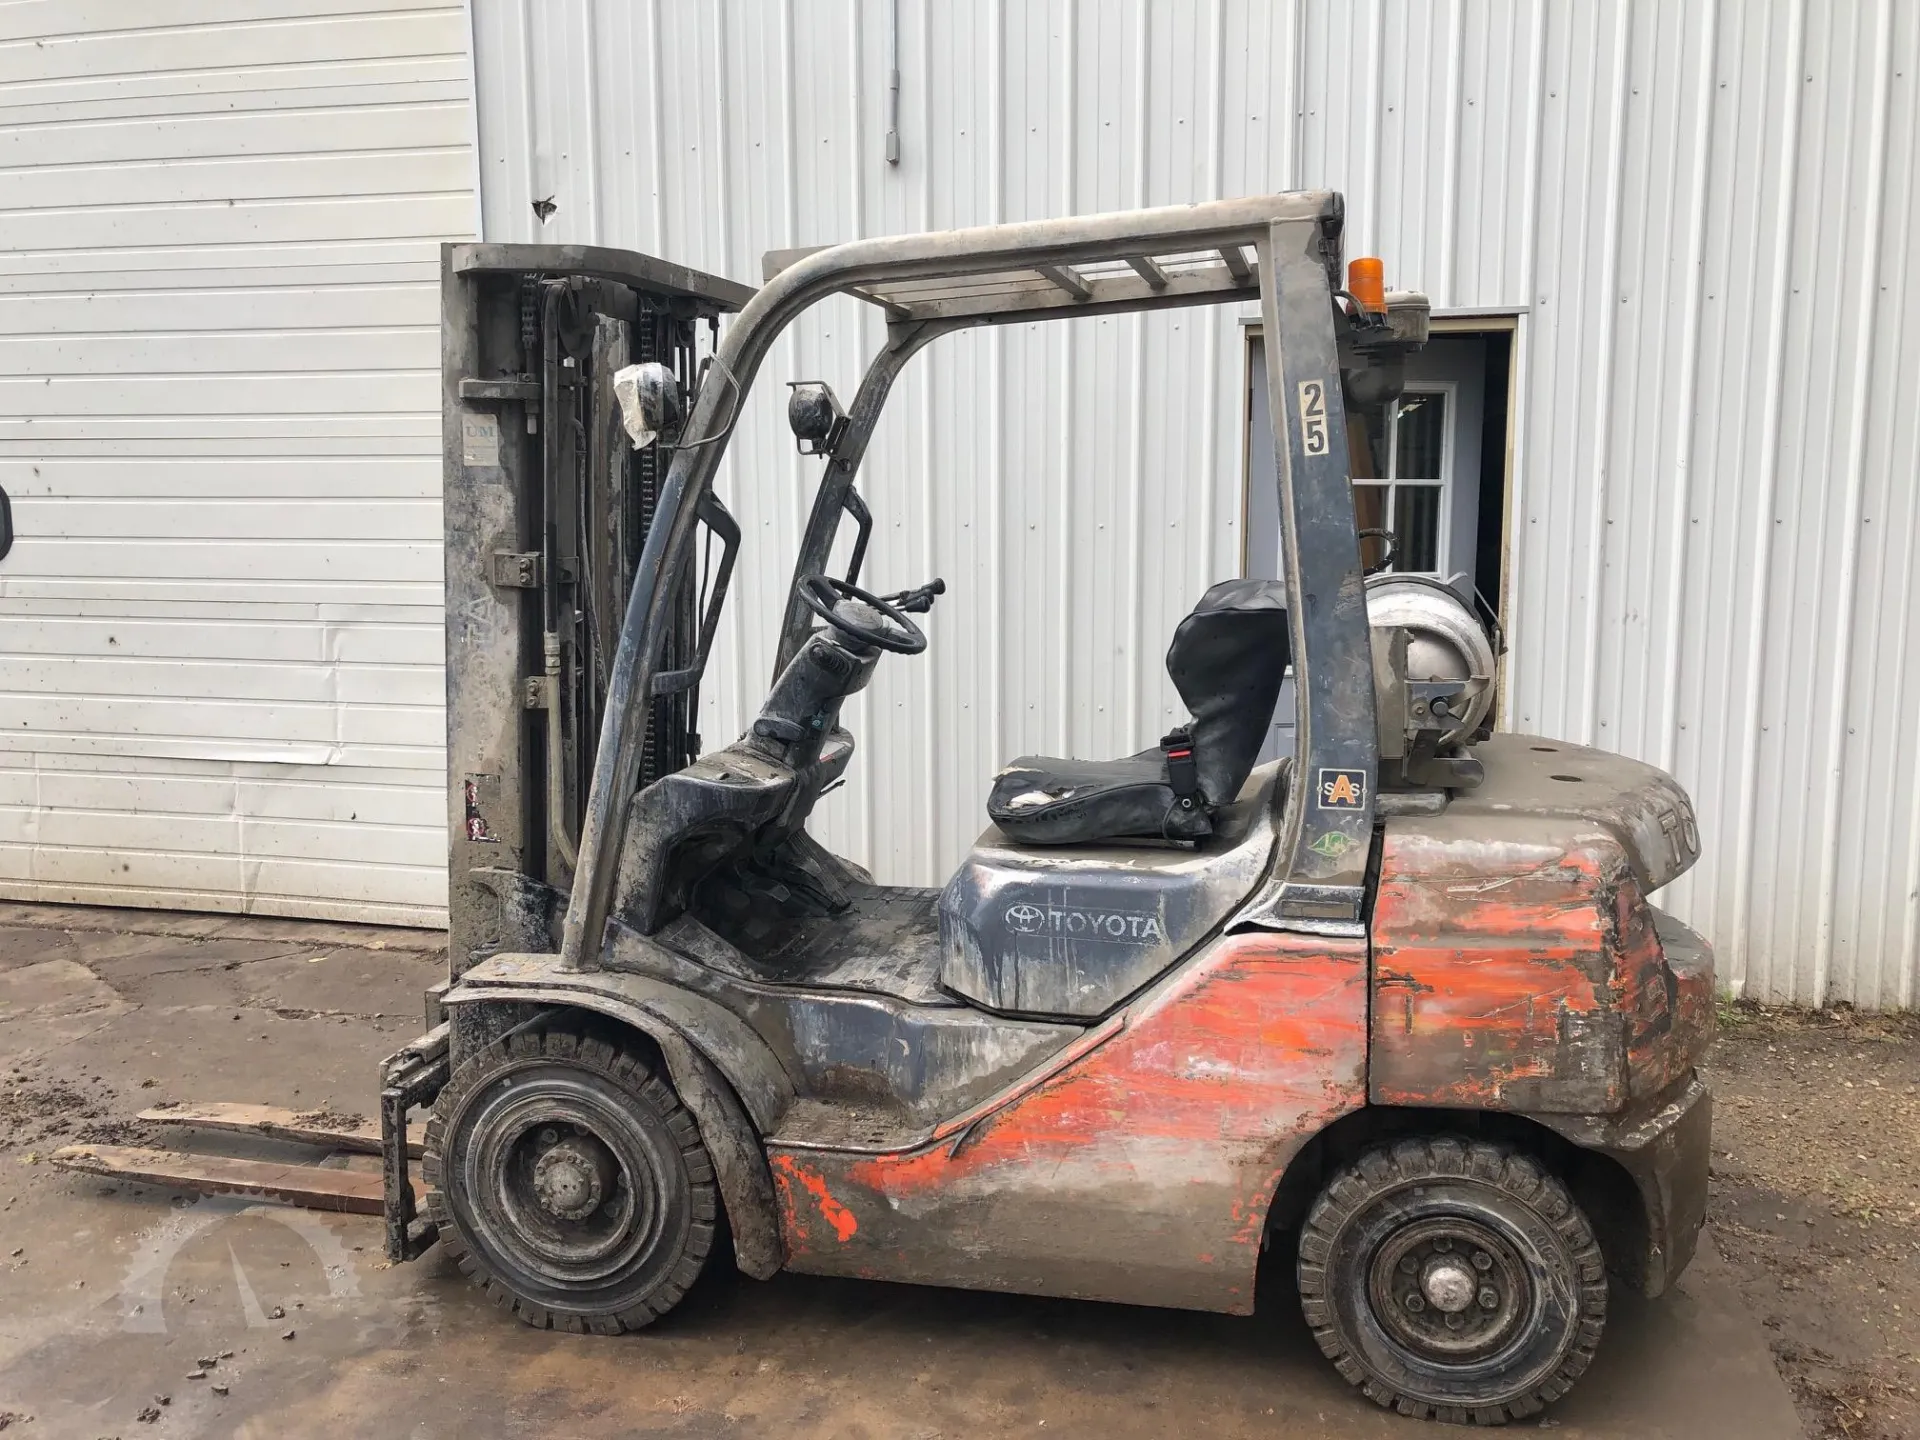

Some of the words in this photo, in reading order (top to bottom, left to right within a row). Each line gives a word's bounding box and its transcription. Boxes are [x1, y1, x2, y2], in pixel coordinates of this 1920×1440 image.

[1304, 383, 1325, 453] 25
[1323, 775, 1360, 804] SAS
[1050, 910, 1161, 939] TOYOTA
